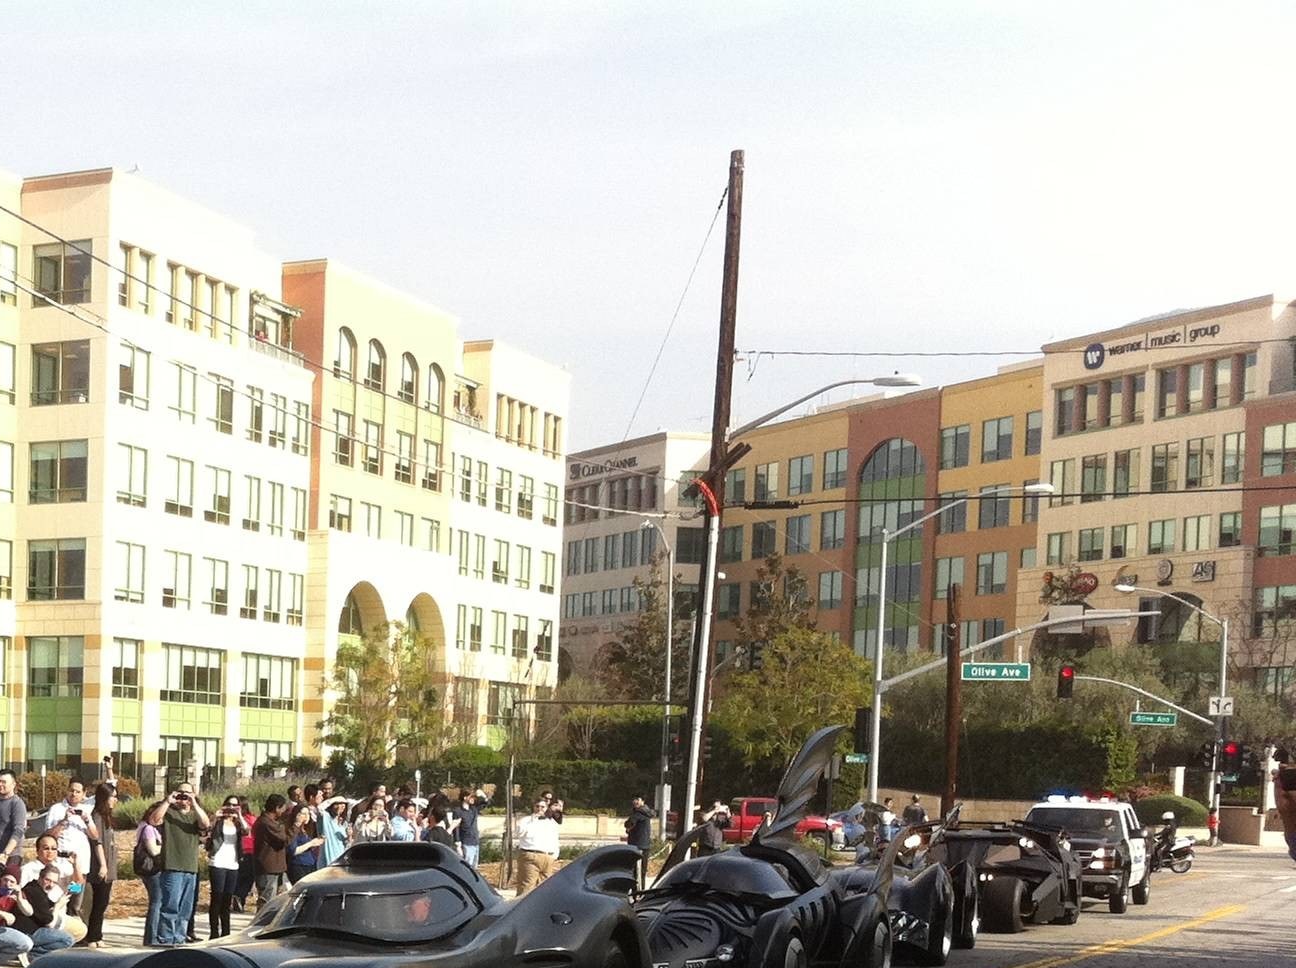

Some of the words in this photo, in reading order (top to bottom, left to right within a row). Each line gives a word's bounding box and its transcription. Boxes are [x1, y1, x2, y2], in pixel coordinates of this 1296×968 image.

[1108, 340, 1142, 357] warner
[1150, 331, 1181, 346] music
[1189, 324, 1220, 342] group
[971, 667, 996, 677] Olive
[1001, 667, 1021, 677] Ave
